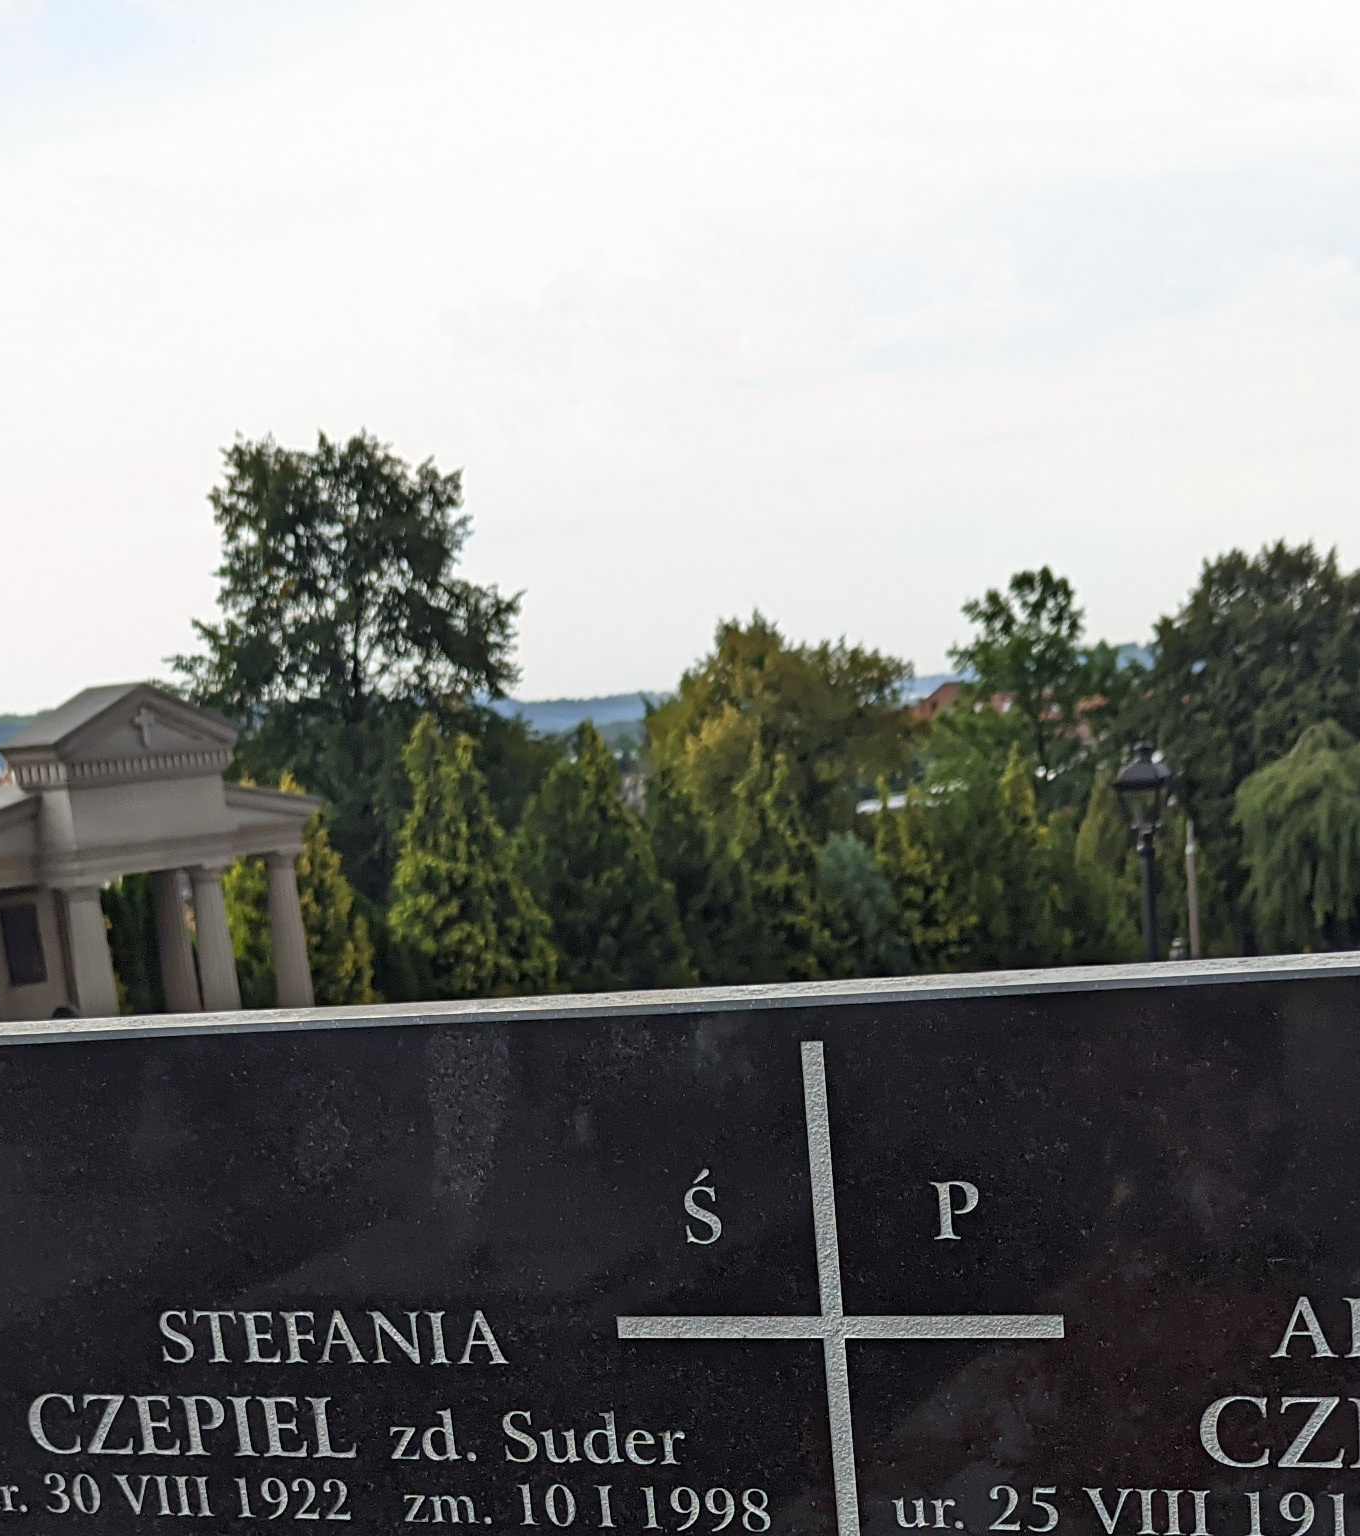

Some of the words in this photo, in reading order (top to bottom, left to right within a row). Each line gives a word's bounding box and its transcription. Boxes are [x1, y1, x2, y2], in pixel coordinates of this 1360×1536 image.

[682, 1168, 724, 1245] Ś
[929, 1180, 980, 1241] P
[157, 1308, 511, 1366] STEFANIA
[26, 1392, 358, 1460] CZEPIEL
[388, 1408, 478, 1463] zd.
[502, 1409, 687, 1466] Suder
[42, 1472, 102, 1516] 30
[112, 1474, 216, 1518] VIII
[234, 1477, 353, 1522] 1922
[402, 1491, 494, 1526] zm.
[519, 1482, 578, 1528] 10
[597, 1484, 617, 1529] I
[642, 1485, 773, 1534] 1998
[891, 1496, 966, 1531] ur.
[988, 1484, 1061, 1533] 25
